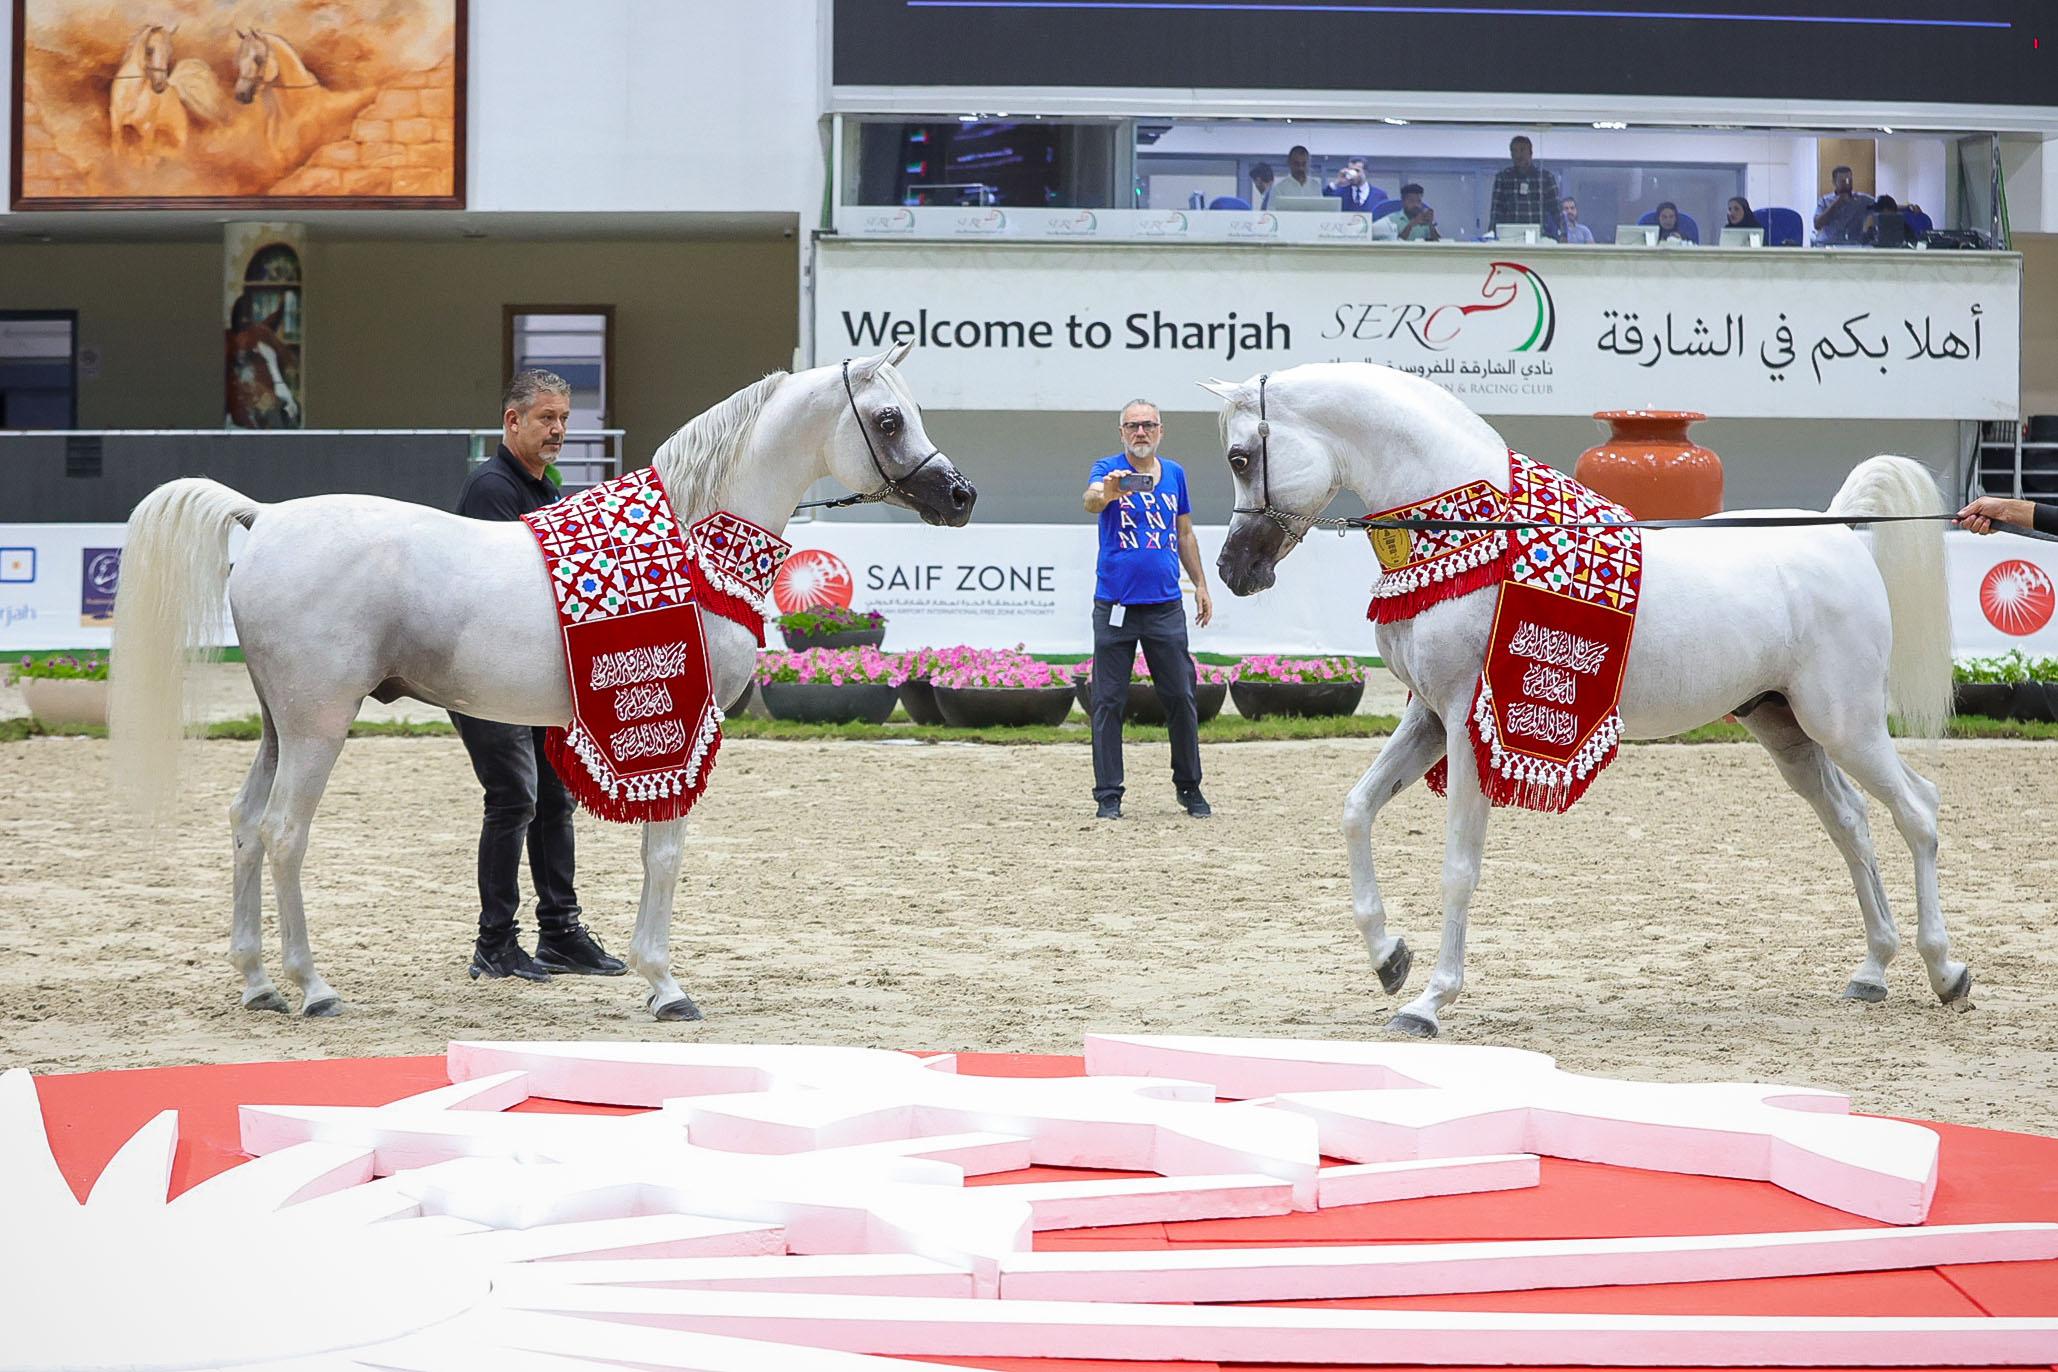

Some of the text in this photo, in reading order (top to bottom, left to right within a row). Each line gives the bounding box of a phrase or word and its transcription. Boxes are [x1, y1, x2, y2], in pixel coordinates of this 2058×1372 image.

[842, 308, 1291, 361] Welcome to Sharjah
[1321, 303, 1462, 352] SERC
[1597, 303, 1983, 385] أهلا بكم في الشارقة
[1460, 358, 1515, 379] الشارقة
[1521, 359, 1553, 381] نادي
[1457, 384, 1467, 394] &
[1470, 384, 1519, 394] RACING
[1522, 384, 1553, 394] CLUB
[866, 564, 1055, 592] SAIF ZONE
